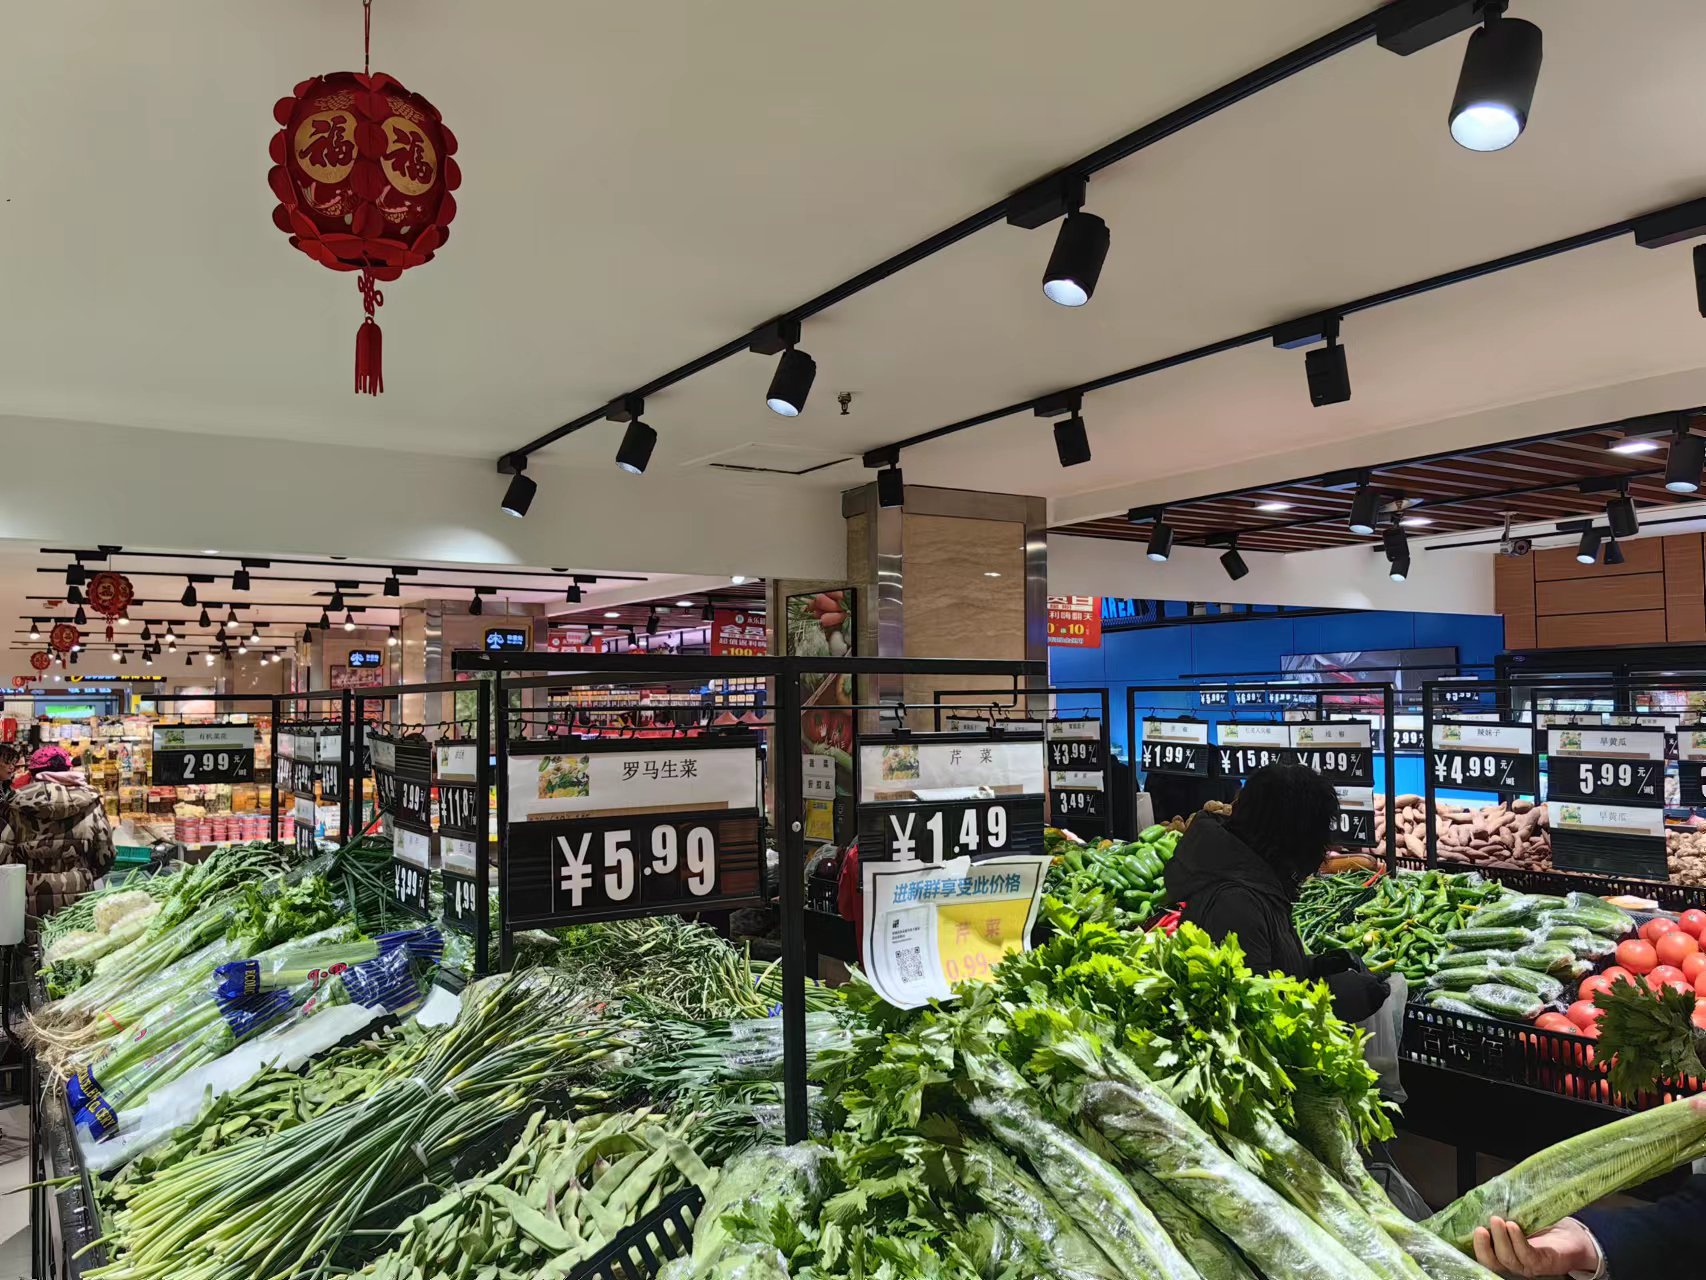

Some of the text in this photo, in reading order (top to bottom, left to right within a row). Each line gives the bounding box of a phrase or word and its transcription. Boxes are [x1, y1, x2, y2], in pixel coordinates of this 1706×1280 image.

[183, 752, 229, 779] 2.99
[949, 748, 993, 765] 芹菜
[1053, 743, 1087, 765] ¥3.99
[1143, 744, 1183, 767] ¥1.99
[1434, 753, 1496, 784] ¥4.99
[622, 758, 698, 781] 罗马生菜
[1579, 763, 1632, 795] 5.99
[1060, 792, 1085, 814] 3.49
[889, 806, 1008, 863] ¥1.49
[557, 824, 716, 908] ¥5.99
[394, 865, 418, 903] ¥3.99
[892, 873, 1021, 904] 进新群享受此价格
[946, 951, 989, 981] 0.99
